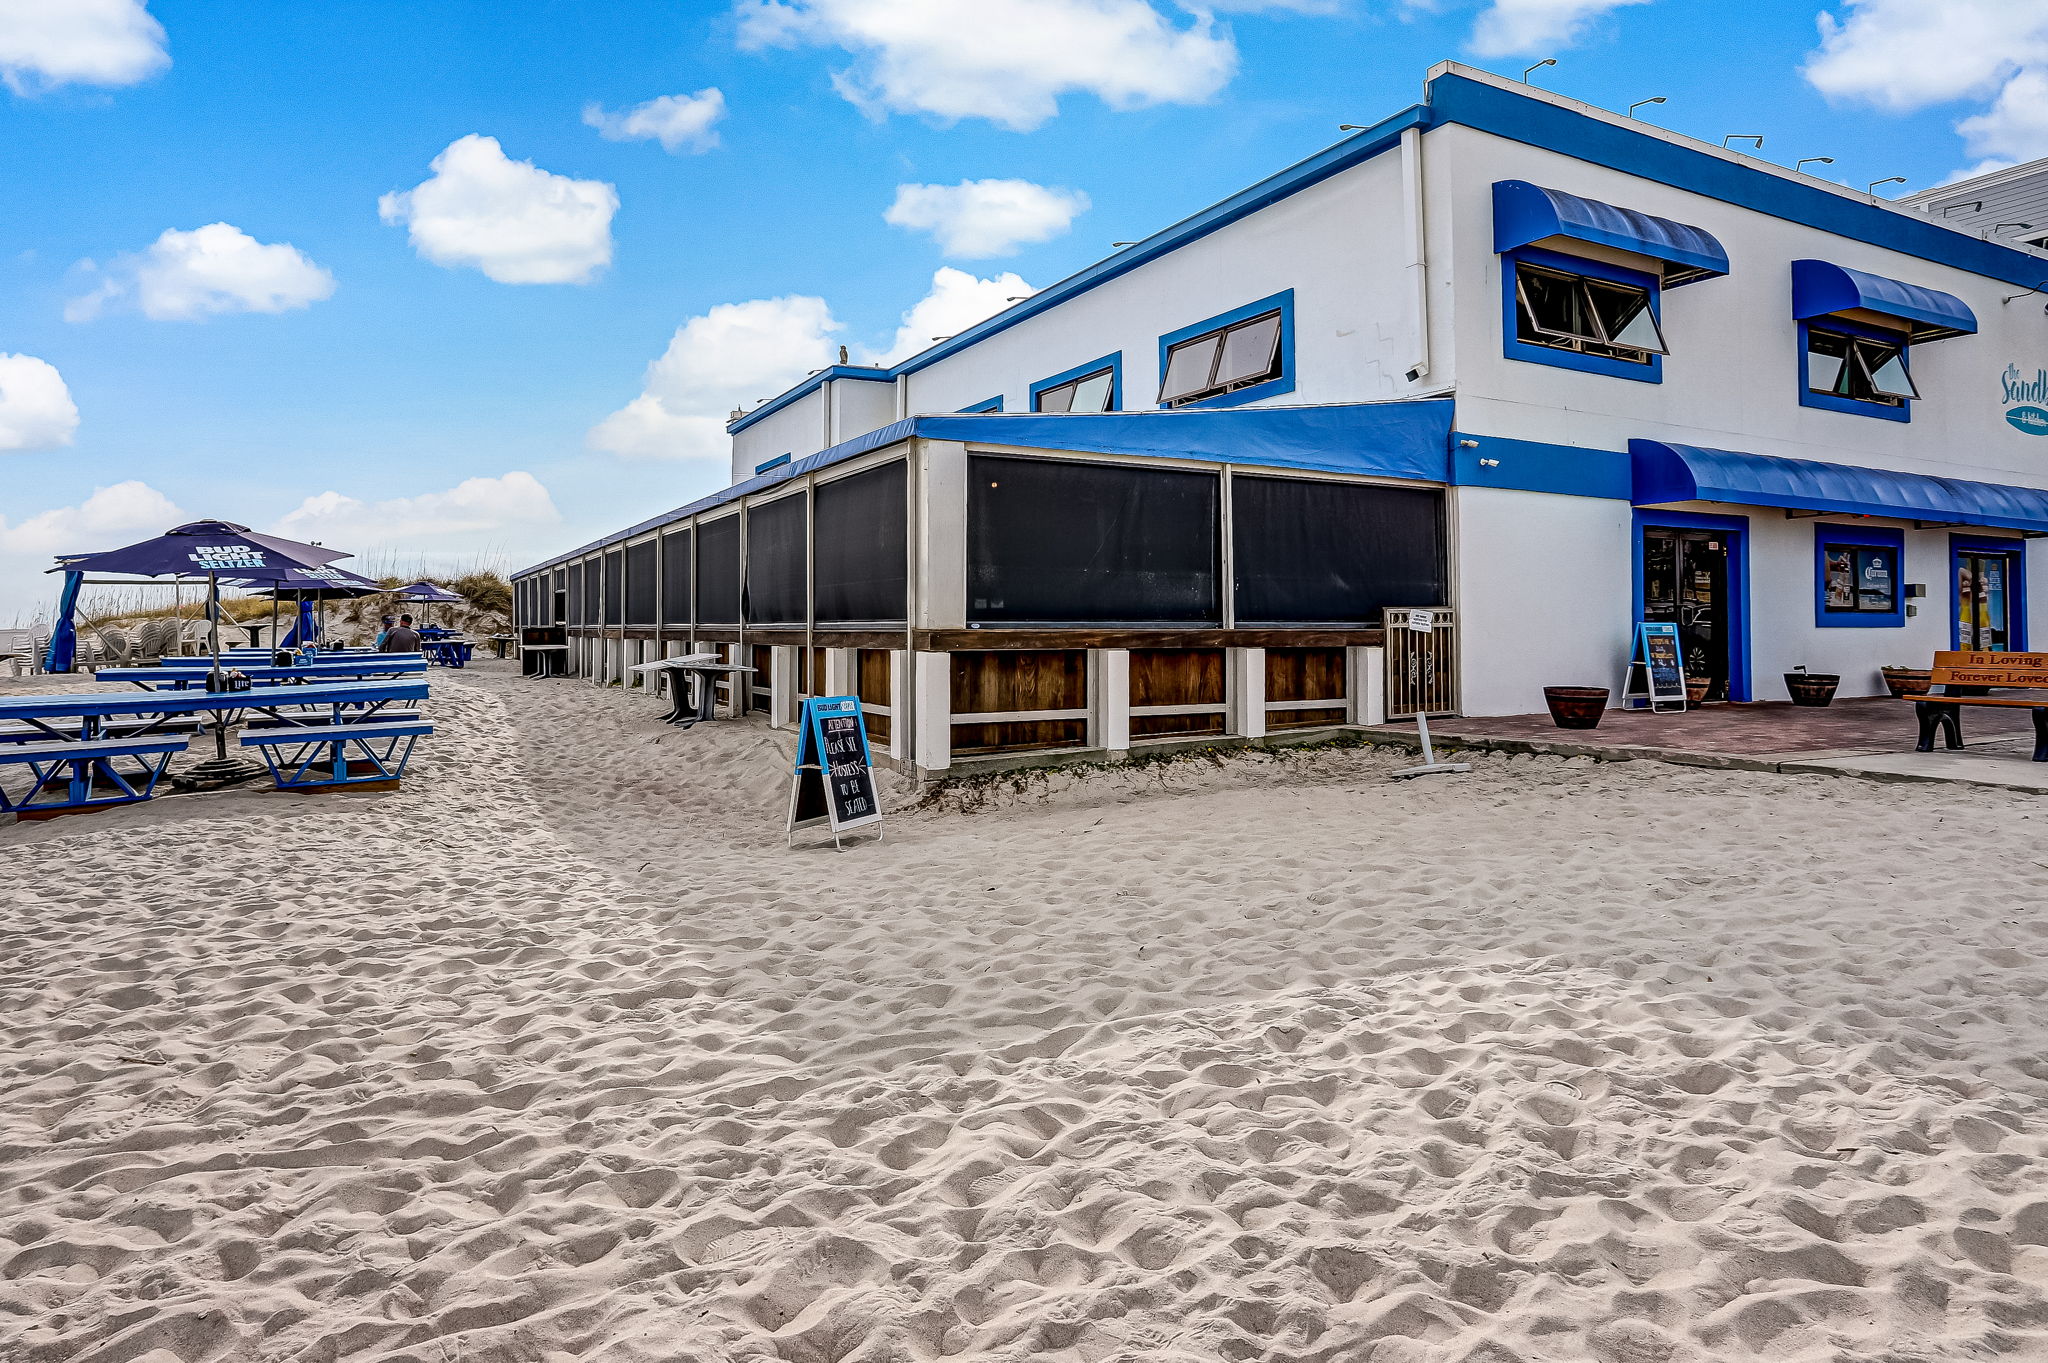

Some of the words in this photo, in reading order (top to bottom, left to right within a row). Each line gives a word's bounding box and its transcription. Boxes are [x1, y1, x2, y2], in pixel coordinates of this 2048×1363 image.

[2008, 363, 2019, 380] the
[188, 552, 264, 561] LIGHT
[195, 546, 251, 554] BUD
[199, 559, 267, 568] SELTZER
[1865, 566, 1888, 580] Corona
[1969, 654, 1984, 664] In
[1990, 655, 2043, 667] Loving
[1951, 671, 2003, 682] Forever
[840, 784, 848, 795] TO
[850, 780, 860, 793] BE
[844, 797, 867, 815] SEATED
